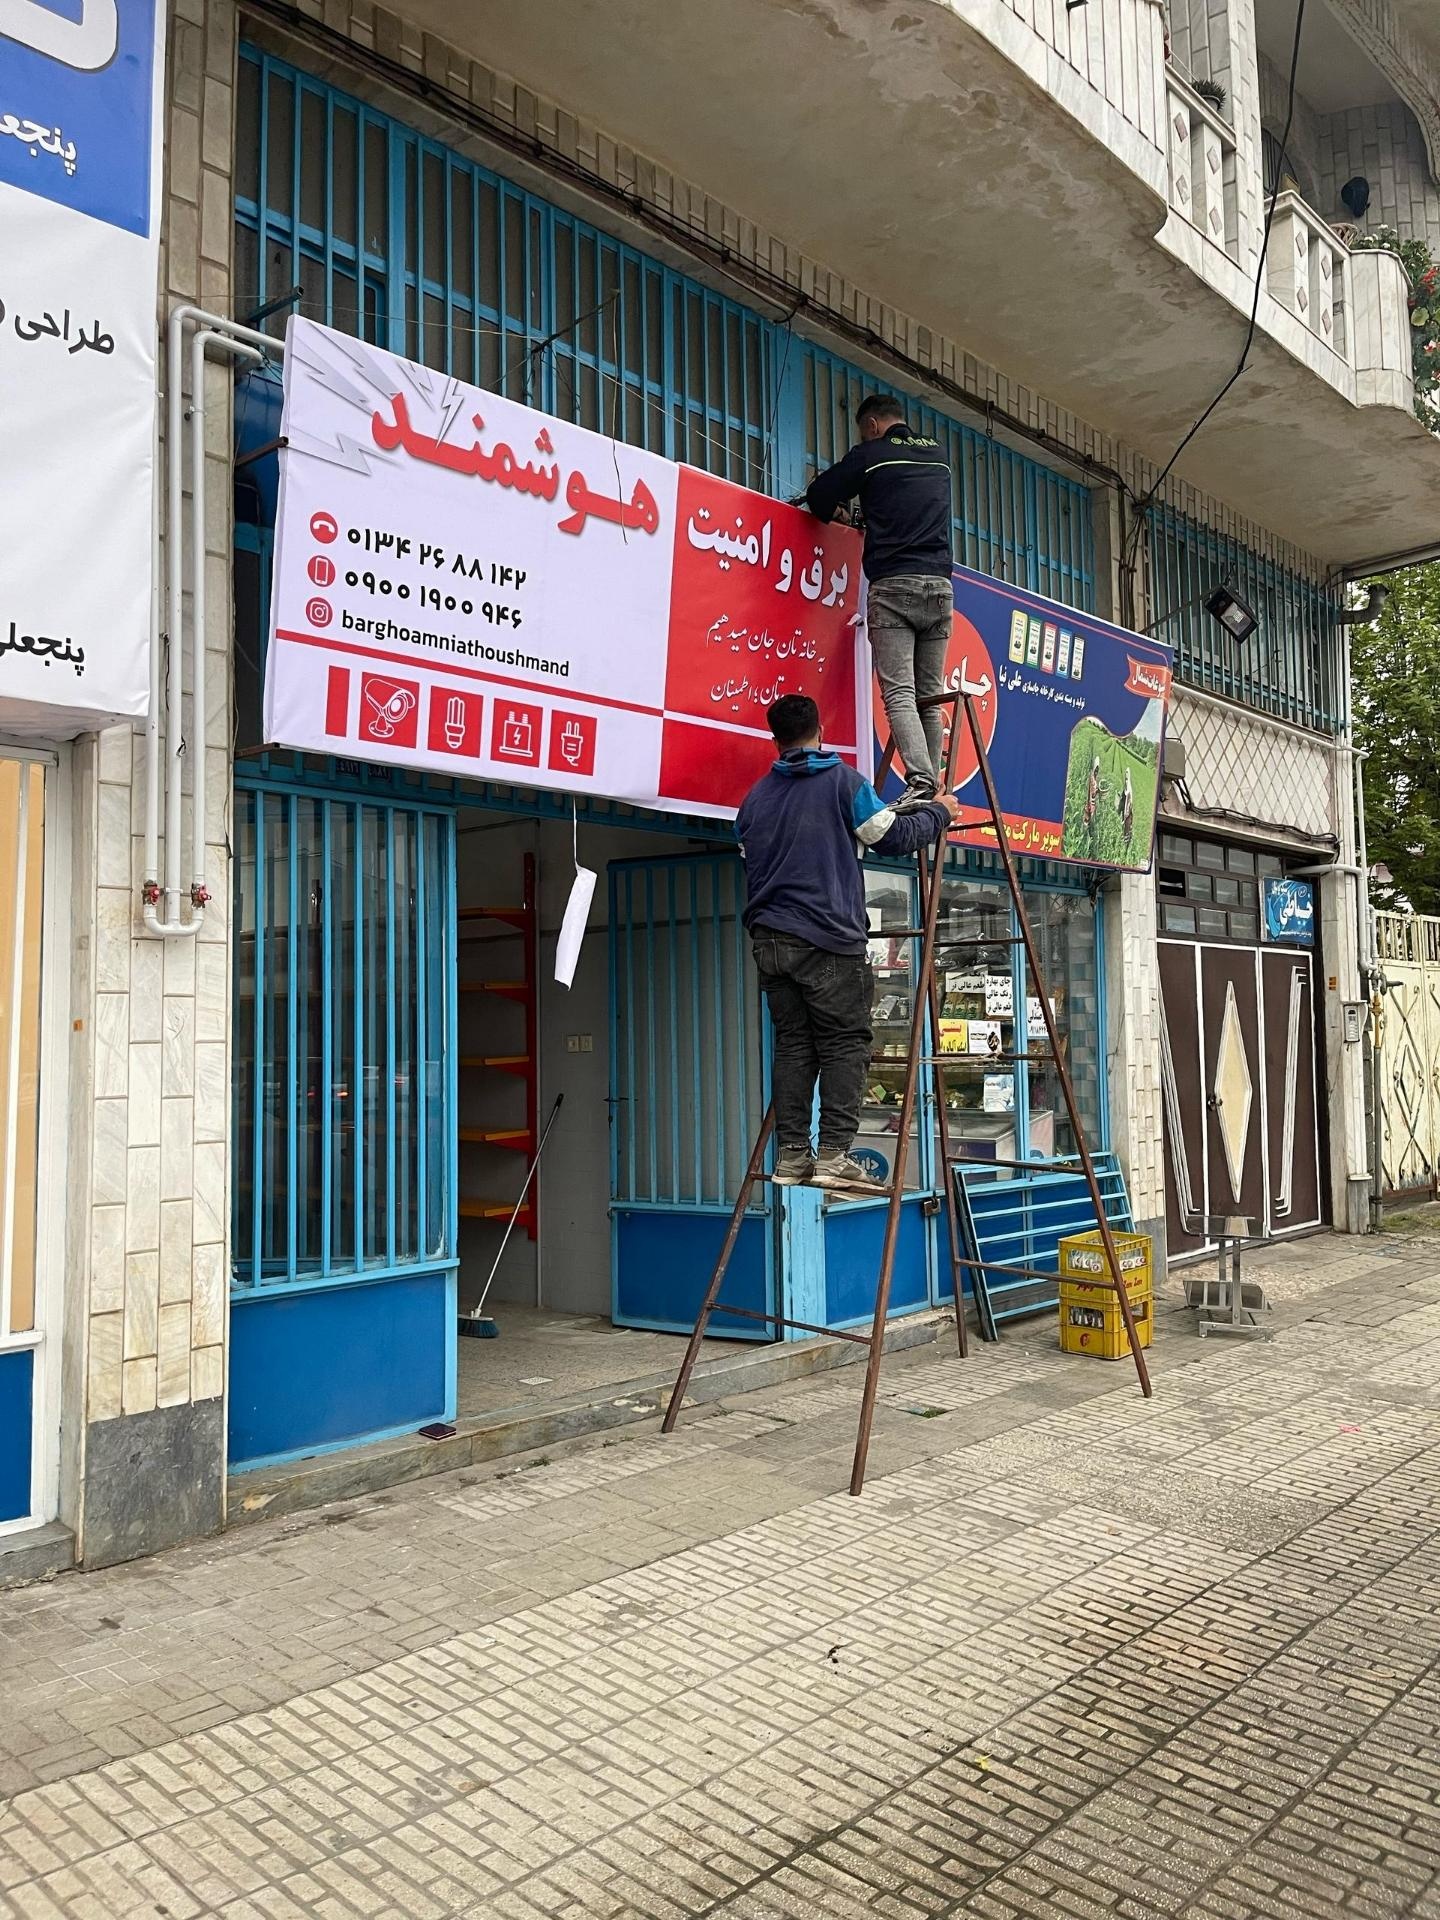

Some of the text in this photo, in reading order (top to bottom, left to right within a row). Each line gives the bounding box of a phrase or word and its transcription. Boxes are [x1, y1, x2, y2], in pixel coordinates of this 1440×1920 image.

[0, 115, 77, 176] پنجع
[14, 309, 115, 355] طراحی
[371, 392, 660, 536] هوشمند
[347, 527, 527, 591] ۰۱۳۴ ۲۶ ۸۸ ۱۴۲
[687, 508, 849, 607] برق و امنیت
[0, 622, 85, 676] پنجعل
[341, 609, 571, 677] barghoamniathoushmand
[747, 628, 775, 660] جان
[943, 655, 992, 712] چای
[1040, 831, 1061, 853] سوپر
